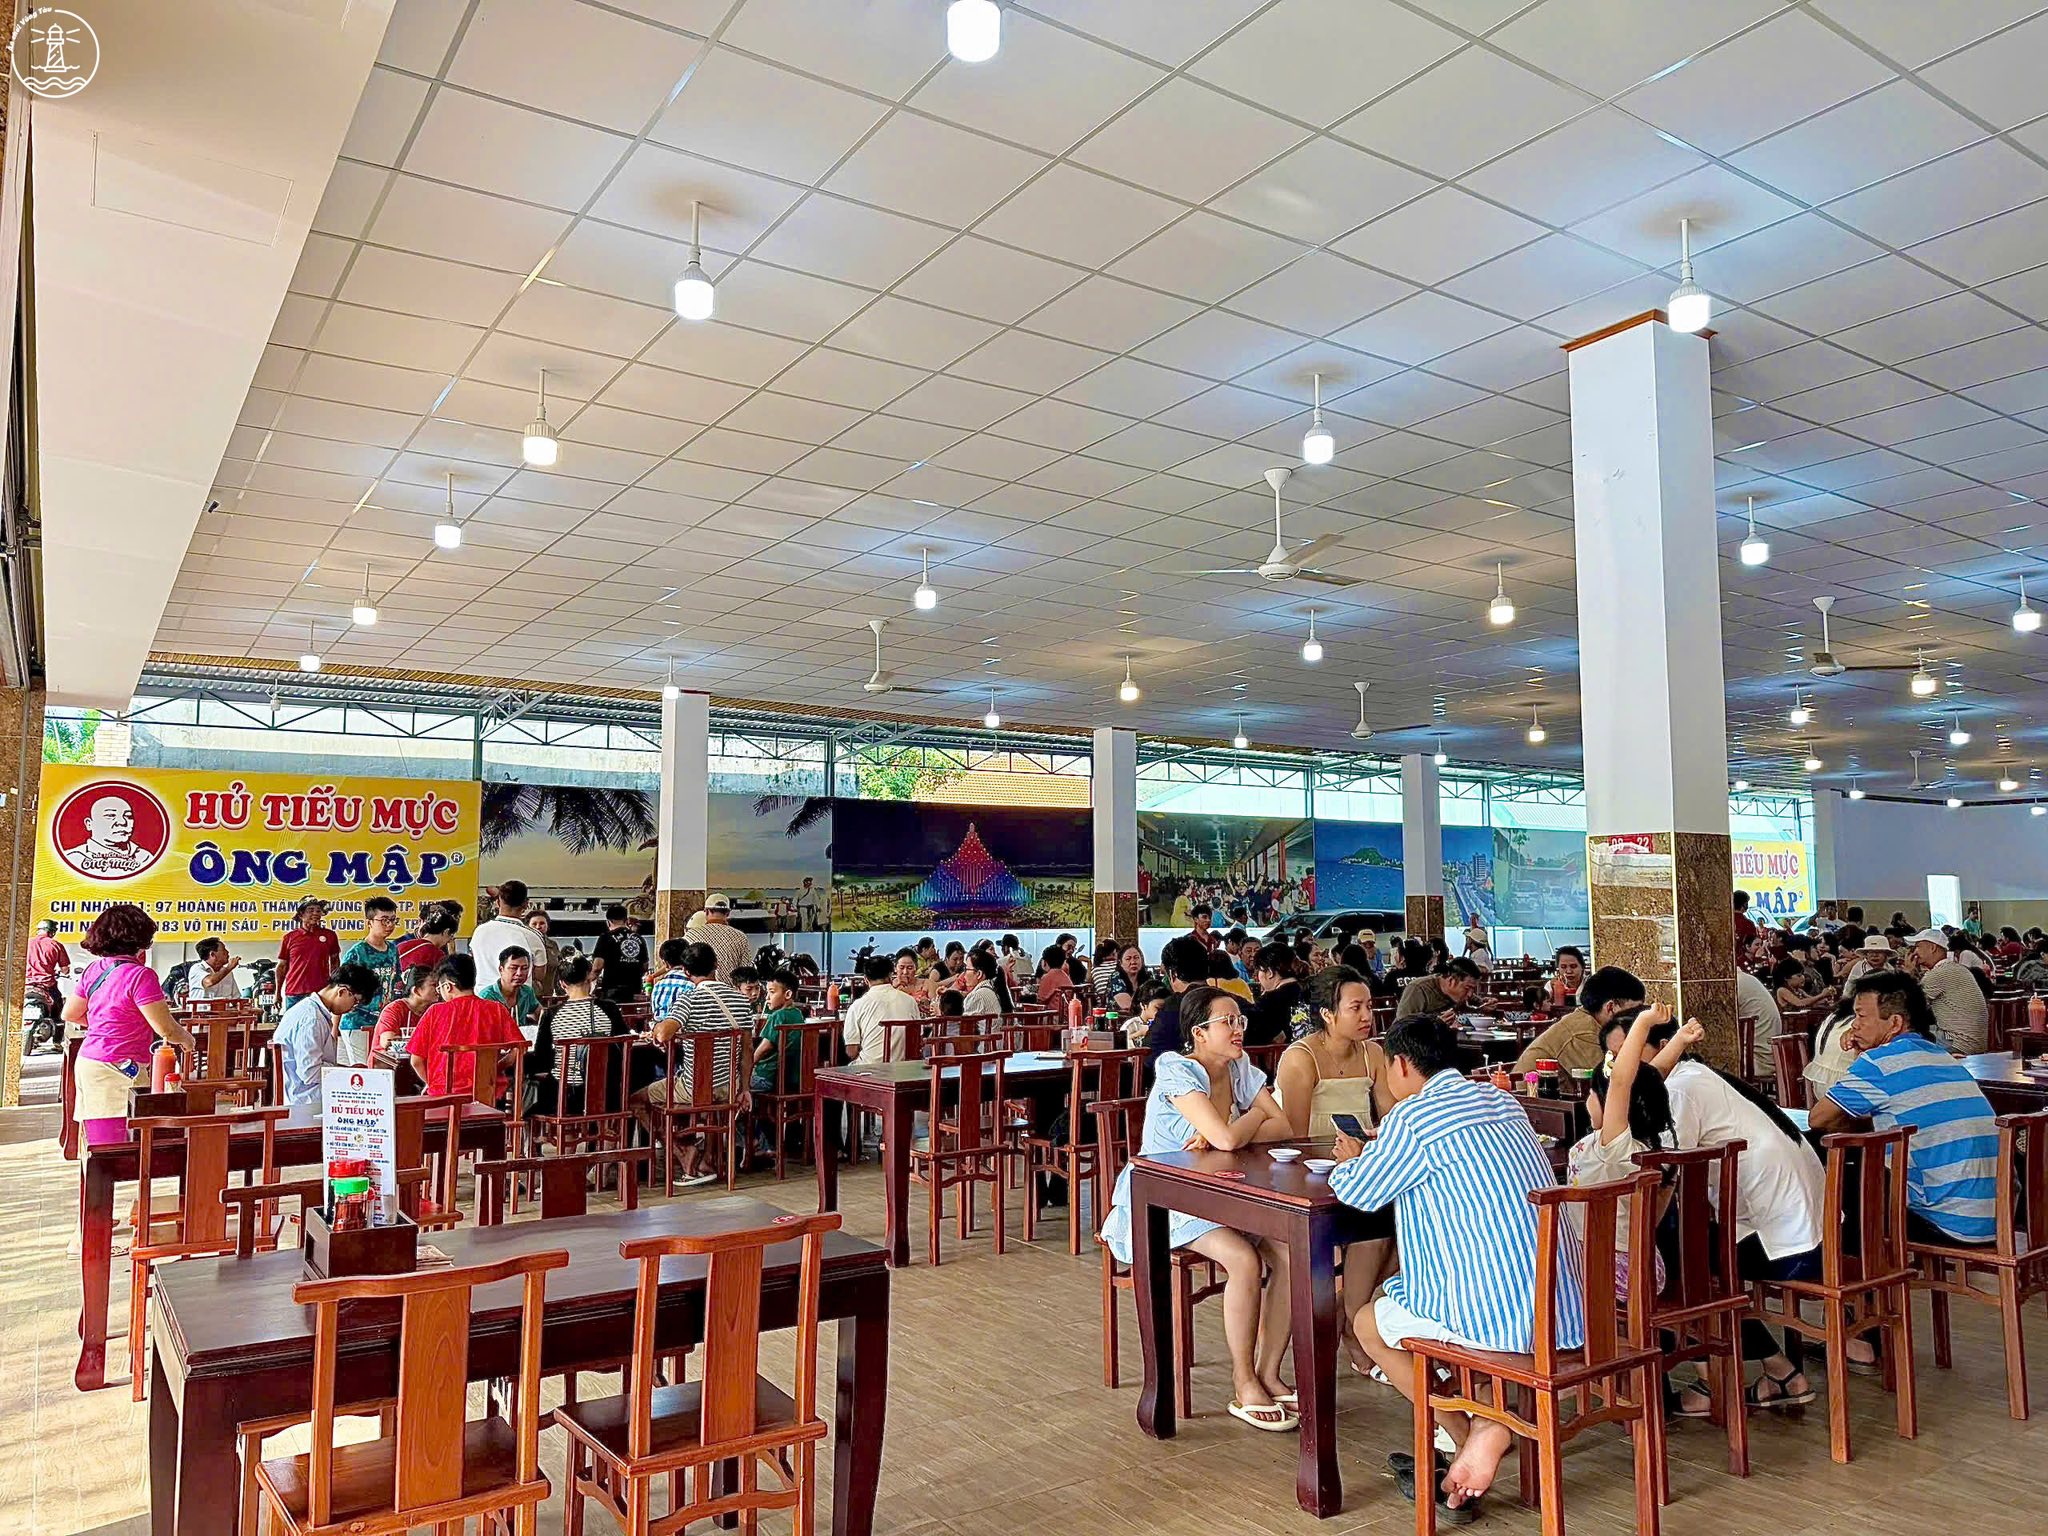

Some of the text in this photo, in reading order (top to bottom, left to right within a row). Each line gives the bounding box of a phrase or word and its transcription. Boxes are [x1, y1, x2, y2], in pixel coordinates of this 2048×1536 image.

[185, 780, 460, 840] HỦ TIẾU MỰC
[188, 840, 311, 886] ÔNG
[1767, 849, 1799, 880] MỰC
[50, 900, 76, 913] CHI
[155, 901, 173, 913] 97
[177, 898, 226, 913] HOÀNG
[229, 900, 258, 913] HOA
[261, 898, 299, 912] THÁM
[327, 898, 363, 912] VŨNG
[398, 900, 415, 912] TP.
[183, 917, 202, 932] VÕ
[205, 919, 227, 934] THỊ
[231, 917, 259, 932] SÁU
[330, 917, 365, 931] VŨNG
